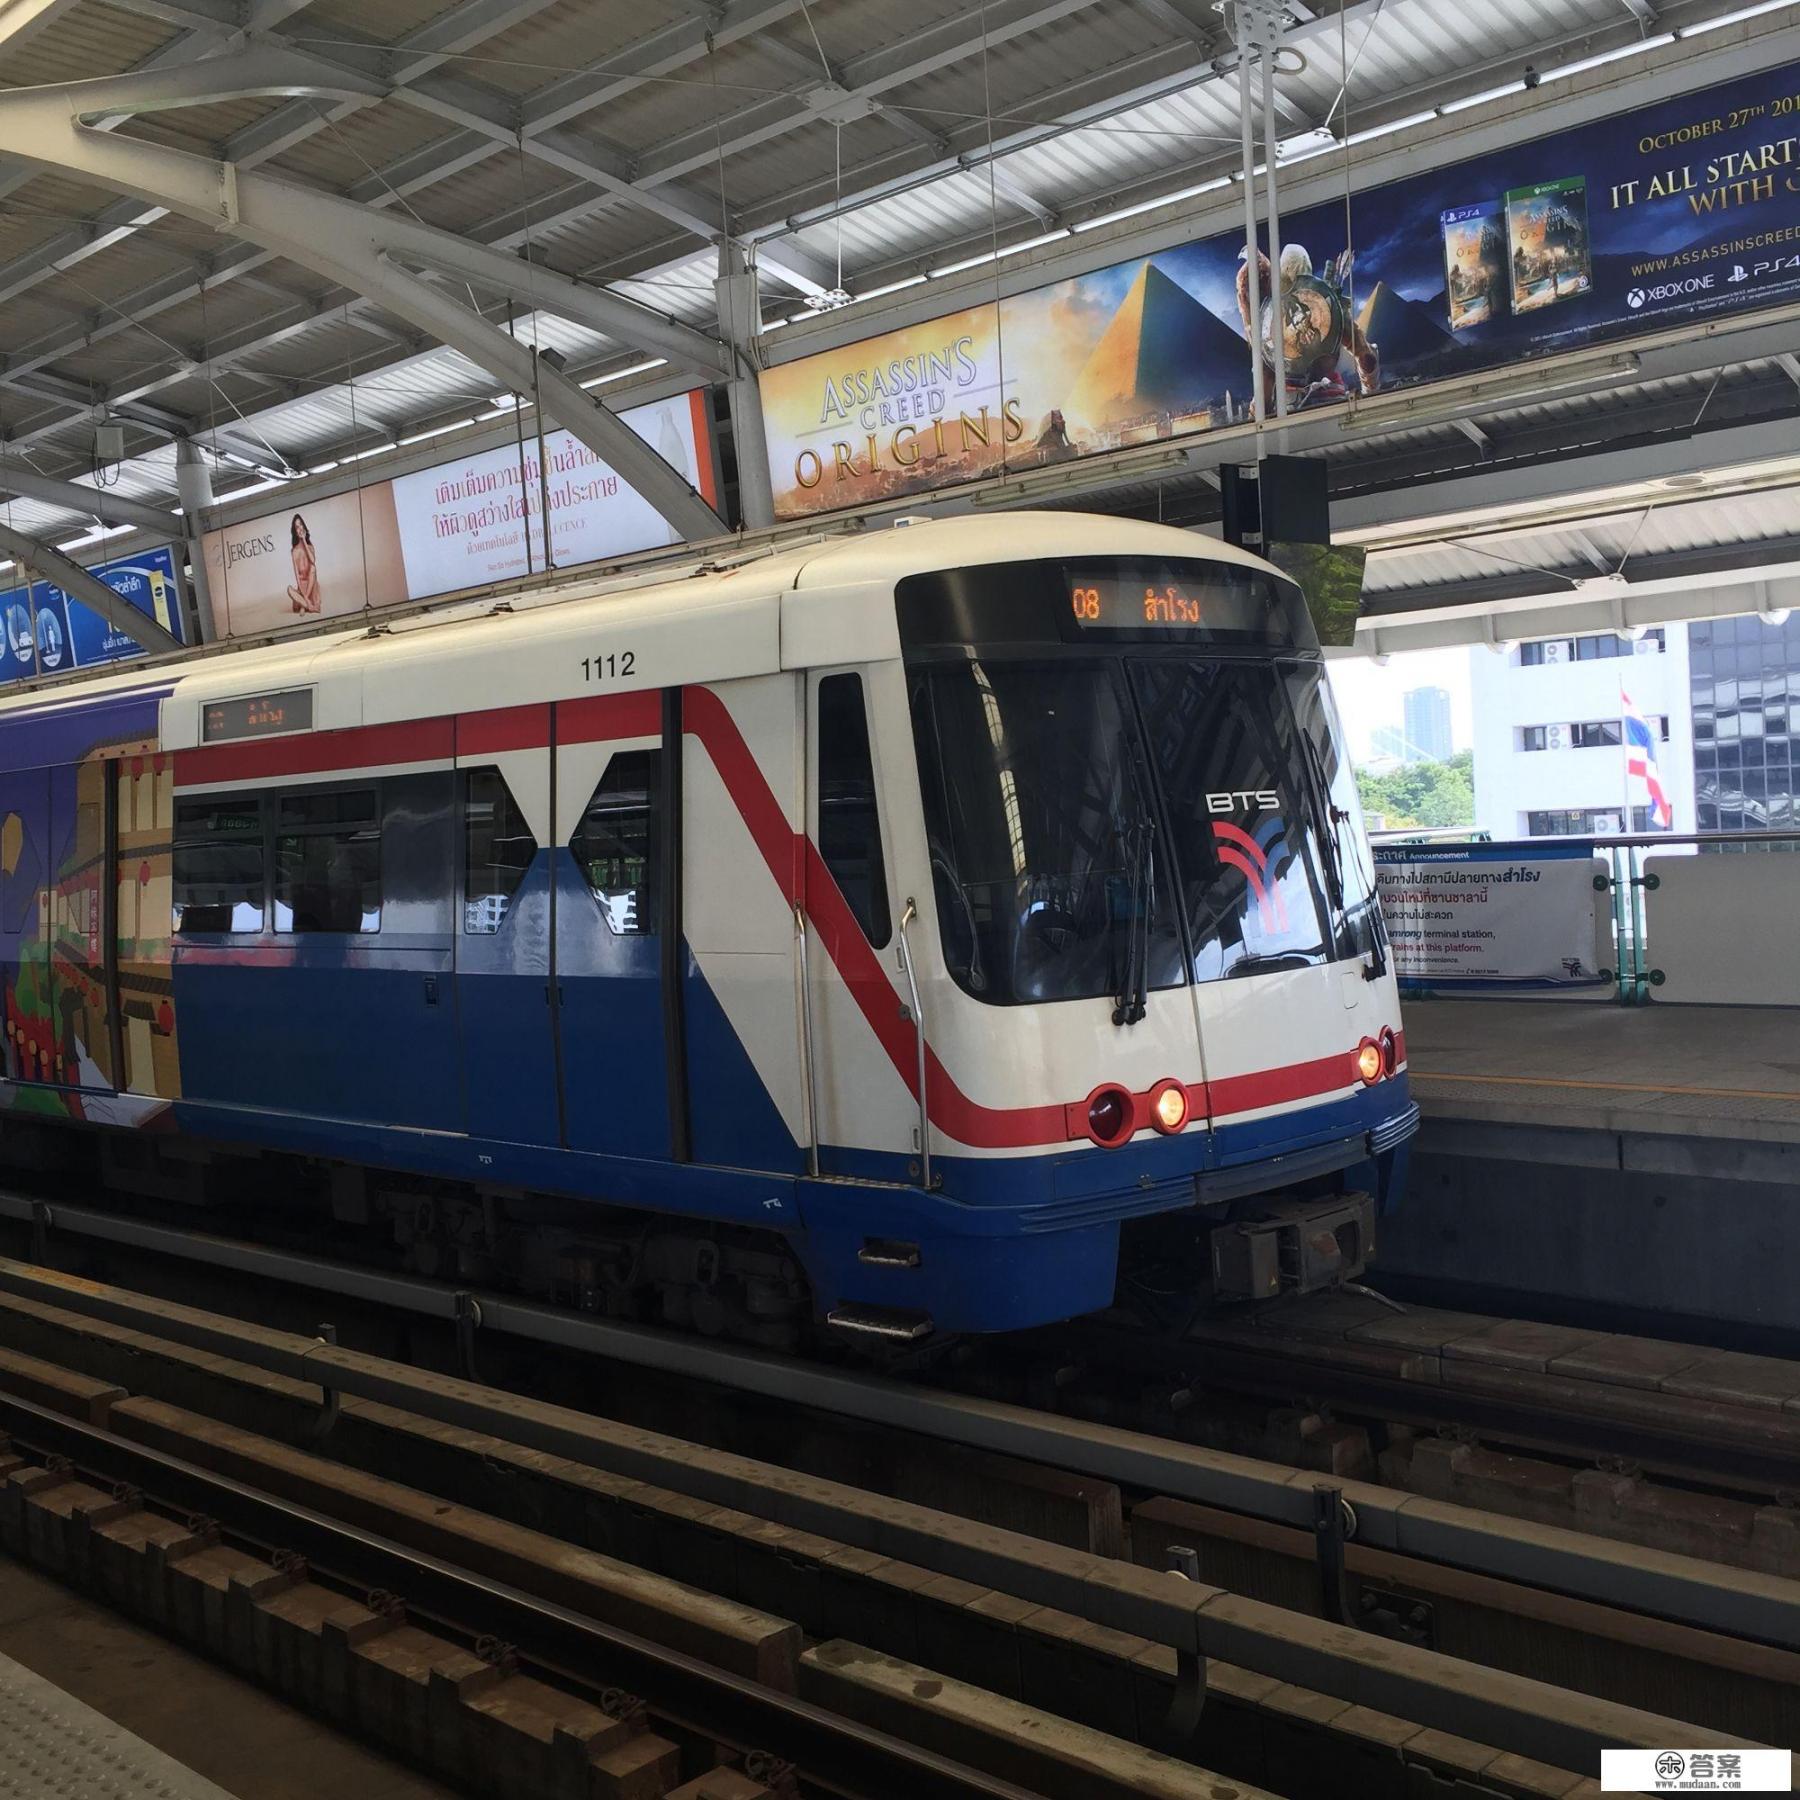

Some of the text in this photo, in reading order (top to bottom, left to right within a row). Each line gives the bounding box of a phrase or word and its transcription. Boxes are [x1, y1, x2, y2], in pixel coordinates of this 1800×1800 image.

[1639, 119, 1723, 153] OCTOBER
[1728, 105, 1765, 129] 27TH
[1610, 181, 1639, 209] IT
[1647, 166, 1698, 200] ALL
[1707, 138, 1800, 183] START
[1688, 174, 1774, 216] WITH
[1458, 208, 1480, 219] PS4
[1647, 281, 1684, 302] XBOX
[1684, 273, 1715, 293] ONE
[1754, 255, 1800, 276] PS4
[860, 388, 945, 430] CREED
[795, 398, 1023, 488] ORIGINS
[226, 535, 275, 569] JERGENS
[1073, 587, 1200, 622] 08 สำโรง
[581, 651, 636, 681] 1112
[1205, 789, 1280, 813] BTS
[1409, 851, 1470, 860] Announcement
[1415, 944, 1426, 952] at
[1427, 943, 1443, 952] this
[1444, 943, 1485, 954] platform.
[1424, 929, 1459, 939] terminal
[1461, 929, 1496, 940] station,
